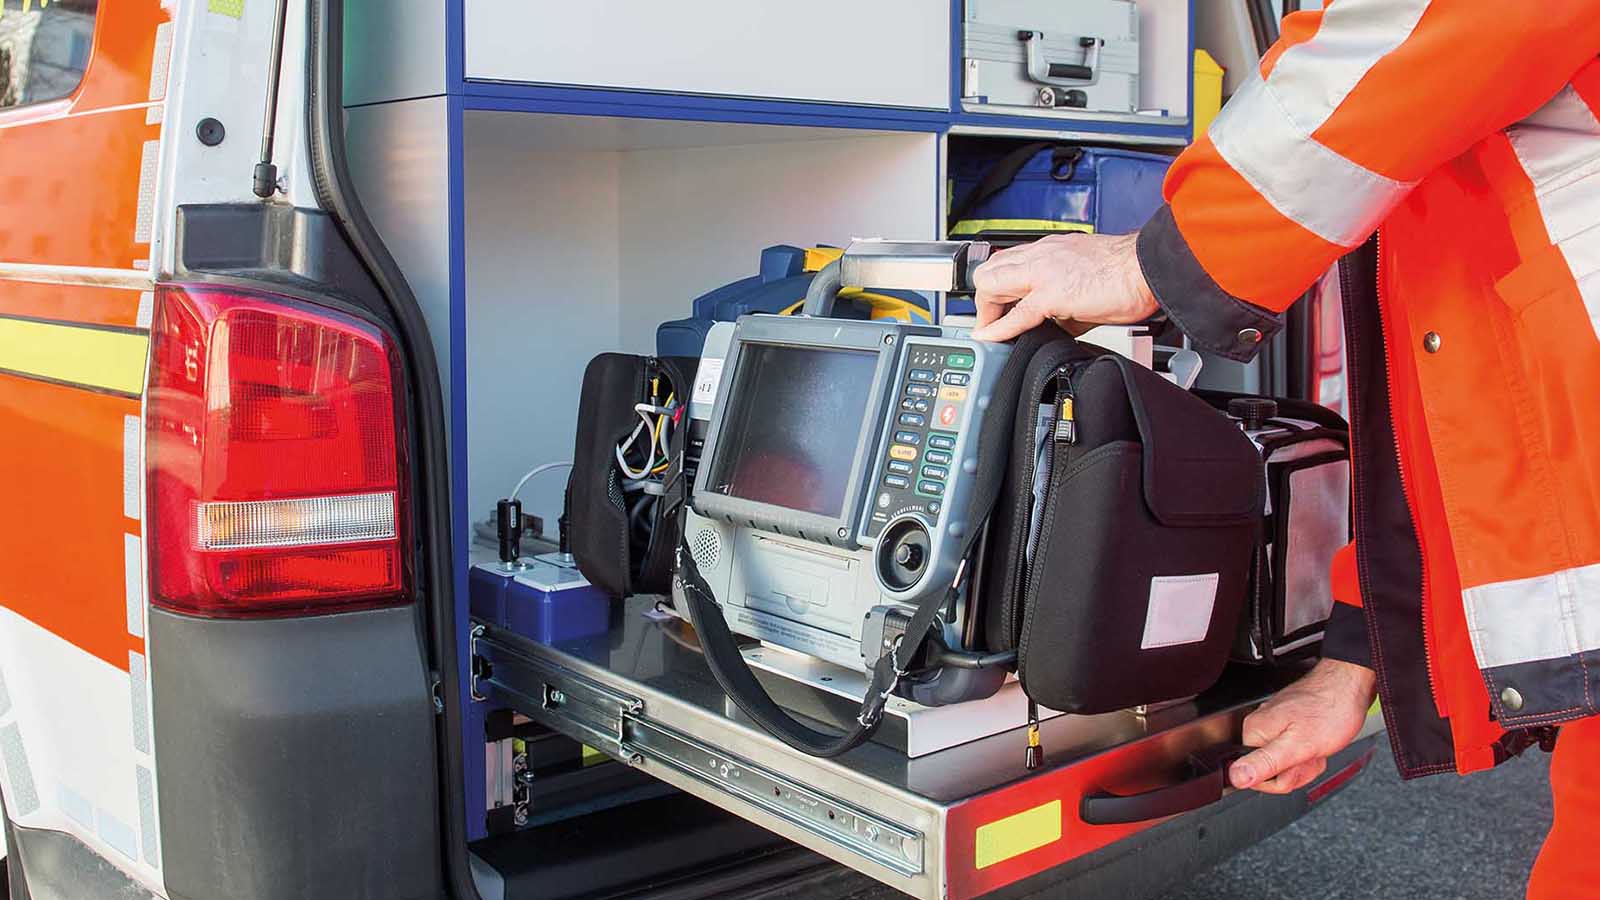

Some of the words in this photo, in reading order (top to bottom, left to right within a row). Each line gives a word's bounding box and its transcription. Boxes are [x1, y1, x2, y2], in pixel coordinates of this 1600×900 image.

[939, 355, 945, 364] 1
[935, 373, 941, 382] 2
[931, 388, 937, 397] 3
